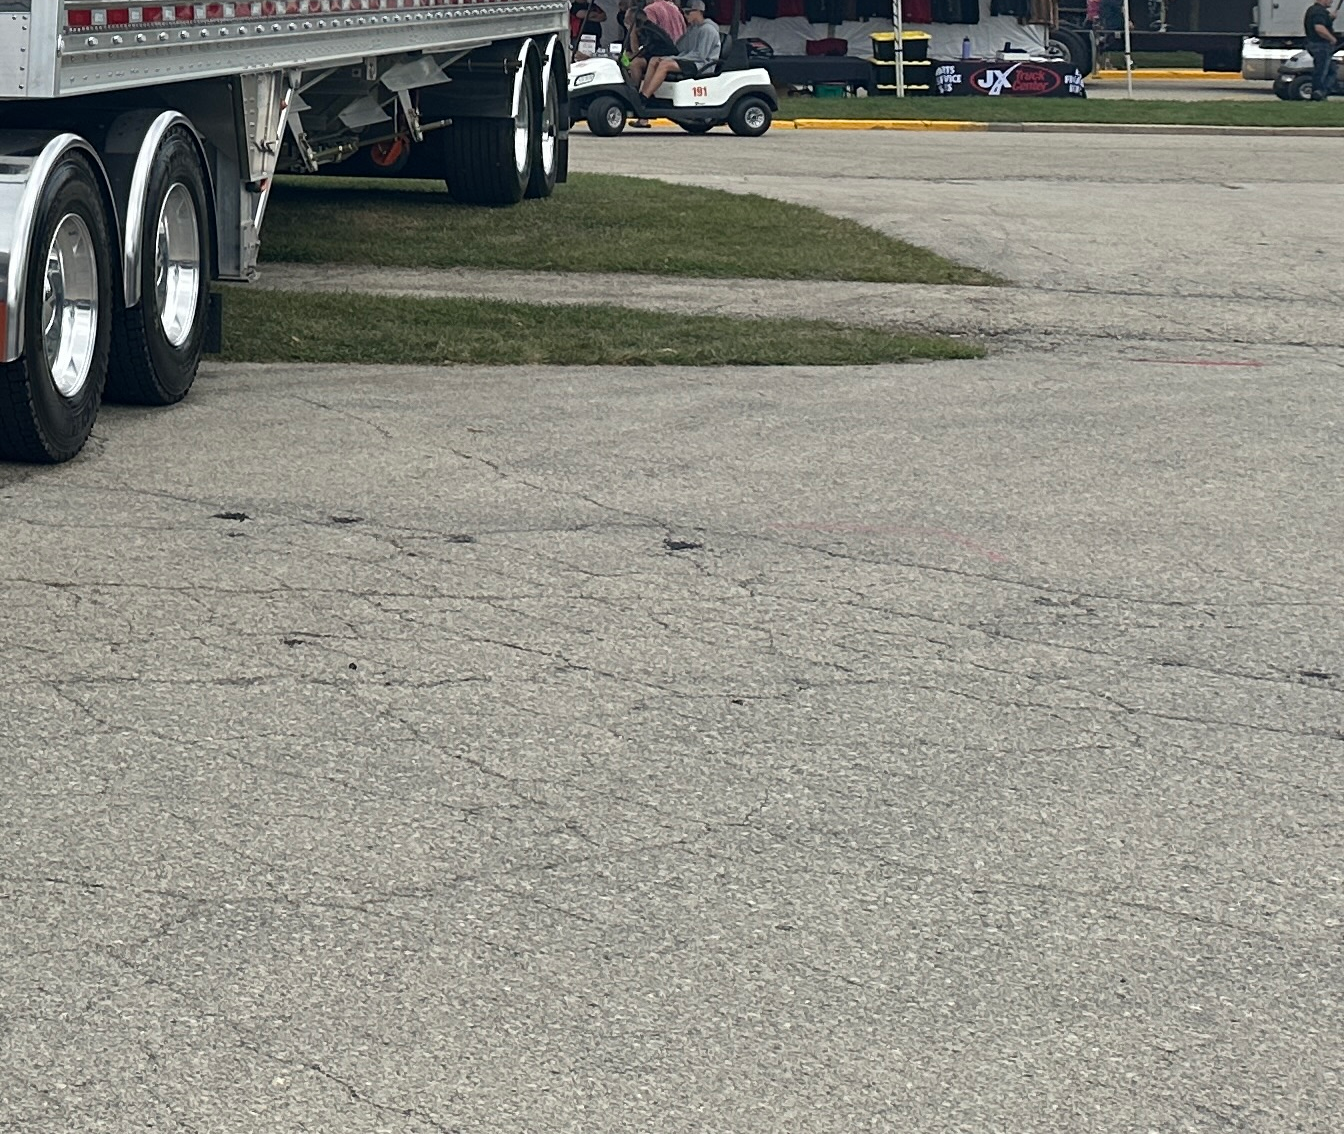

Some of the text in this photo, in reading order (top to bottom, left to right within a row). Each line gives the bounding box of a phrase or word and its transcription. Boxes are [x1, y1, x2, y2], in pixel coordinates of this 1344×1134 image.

[977, 62, 1023, 96] JX
[1014, 68, 1047, 81] Truck
[1012, 79, 1049, 91] Center
[692, 86, 708, 98] 191
